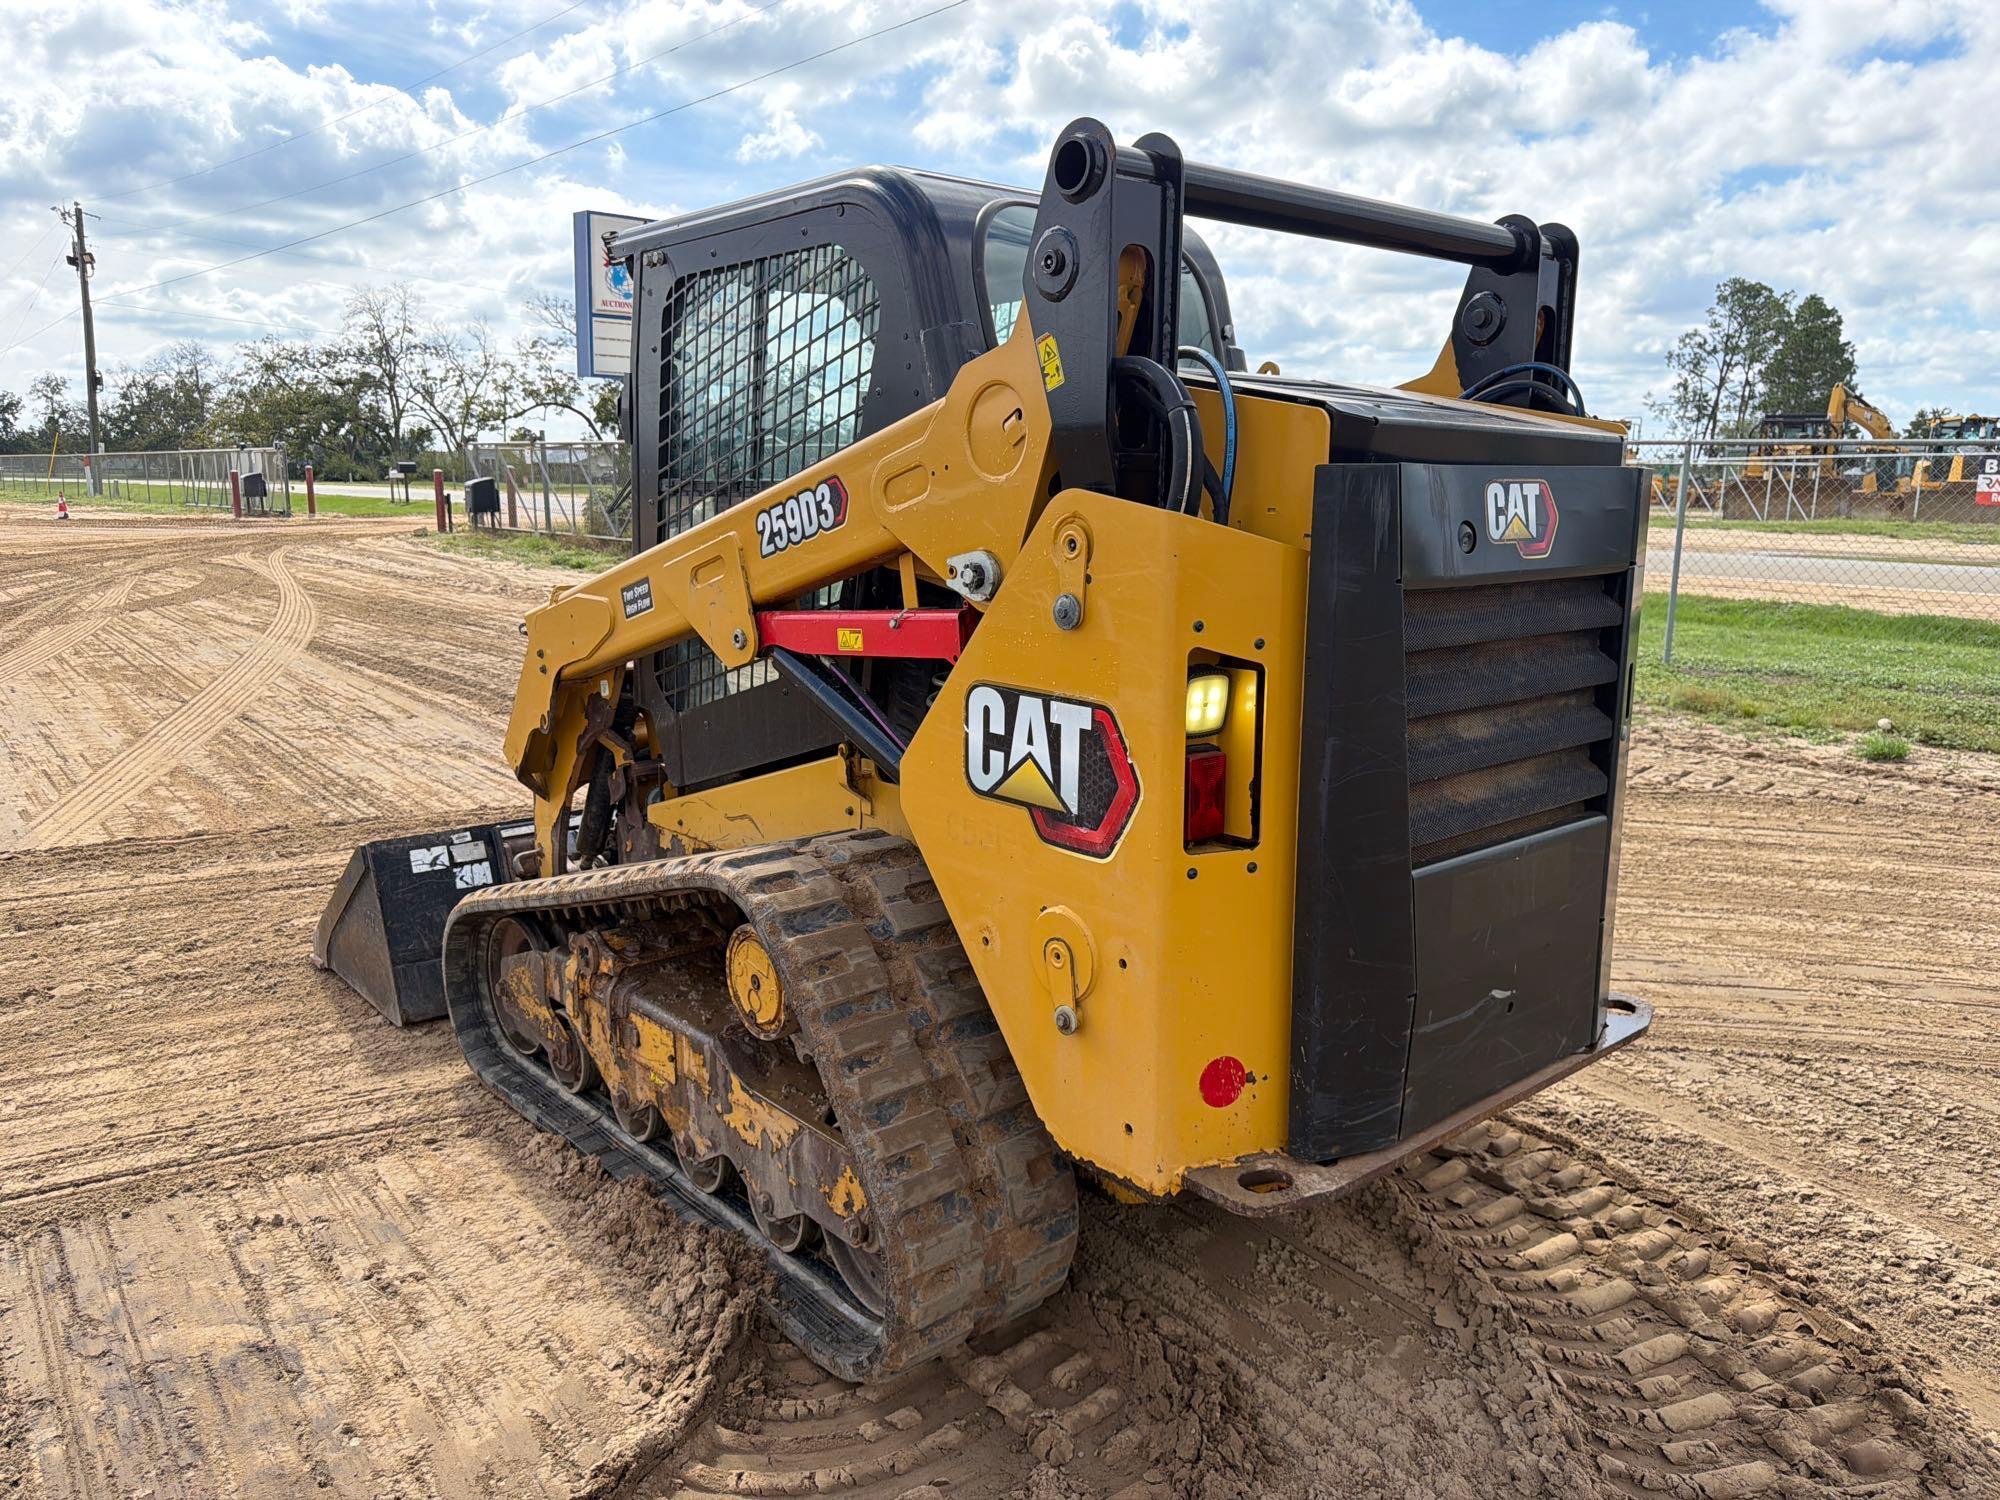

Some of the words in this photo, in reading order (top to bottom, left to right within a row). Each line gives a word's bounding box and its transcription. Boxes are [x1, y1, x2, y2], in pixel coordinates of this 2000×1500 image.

[756, 482, 835, 557] 259D3
[1487, 482, 1540, 540] CAT
[968, 686, 1092, 816] CAT
